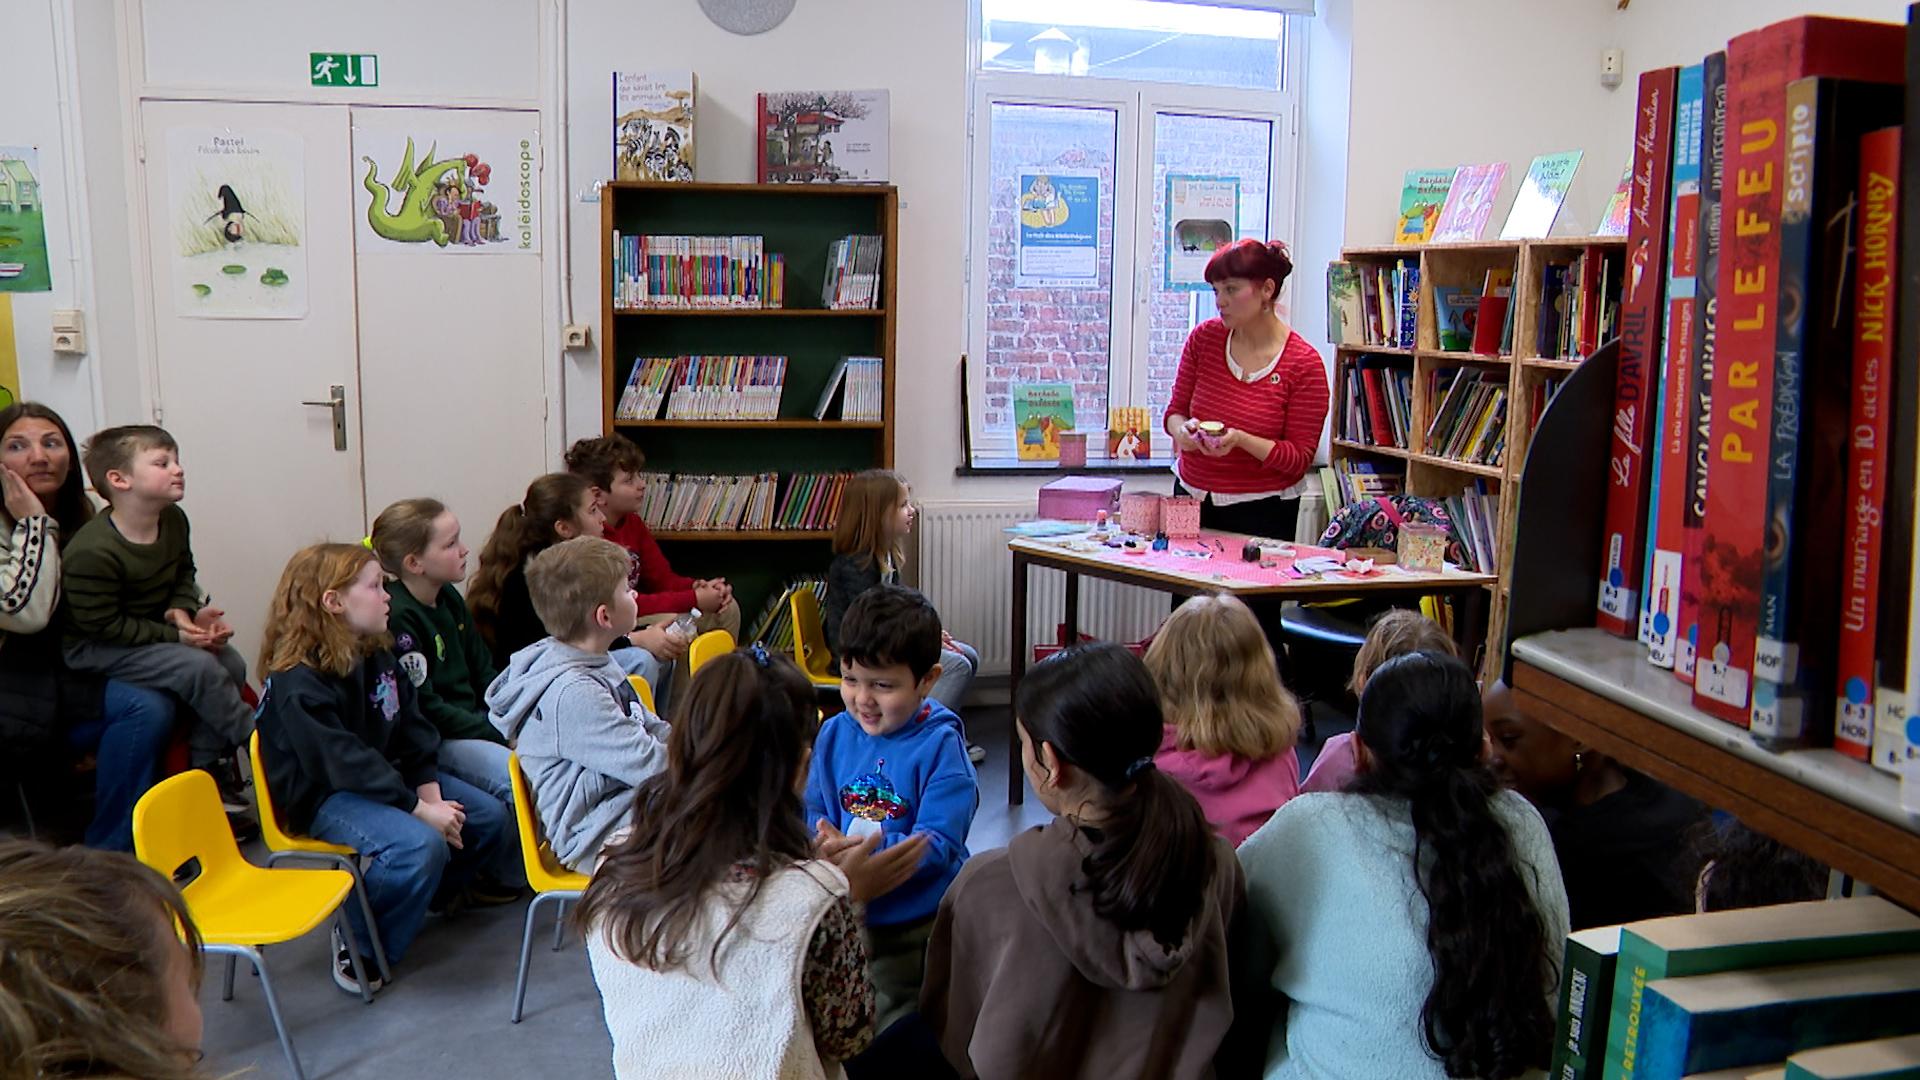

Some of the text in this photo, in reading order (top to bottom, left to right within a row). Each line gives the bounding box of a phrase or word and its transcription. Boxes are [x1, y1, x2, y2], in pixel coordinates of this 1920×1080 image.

[213, 137, 244, 146] Pastel
[1633, 88, 1659, 228] Annelise Heurtier
[1677, 102, 1691, 165] ANNELISE
[1688, 98, 1702, 165] HEURTIER
[1788, 104, 1812, 204] scripto
[1865, 172, 1894, 270] HORNBY
[1721, 118, 1778, 463] PAR LE FEU
[1679, 301, 1692, 346] nuages
[1619, 306, 1647, 401] D'AVRIL
[1677, 347, 1687, 365] les
[1674, 368, 1686, 418] naissent
[1613, 404, 1642, 456] fille
[1673, 420, 1683, 437] où
[1774, 451, 1793, 480] LA
[1844, 357, 1880, 632] Un mariage en 10 actes
[1756, 652, 1780, 668] HOF
[1840, 721, 1868, 739] HOR
[1623, 965, 1647, 1071] RETROUVÉE
